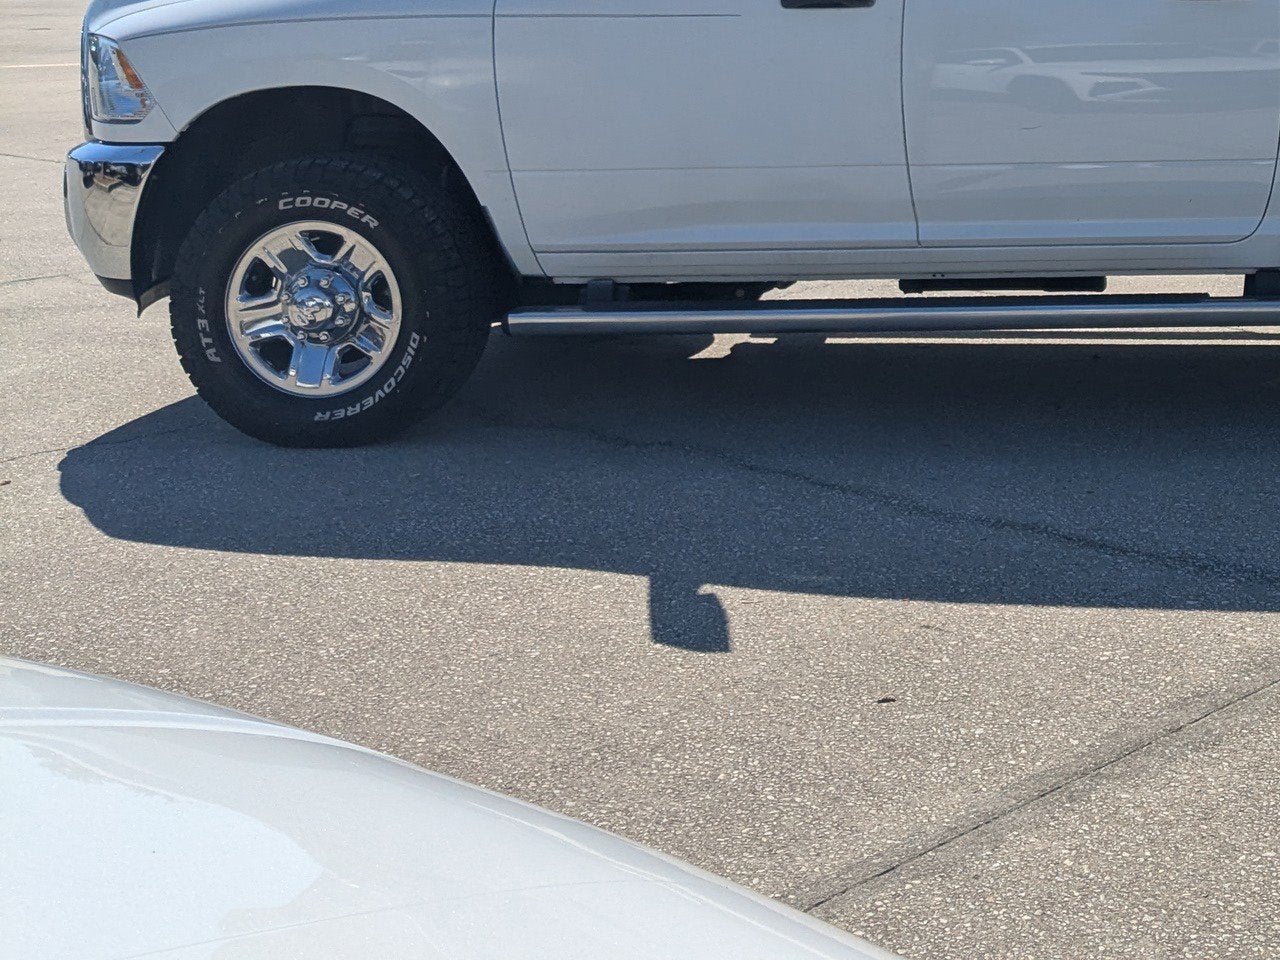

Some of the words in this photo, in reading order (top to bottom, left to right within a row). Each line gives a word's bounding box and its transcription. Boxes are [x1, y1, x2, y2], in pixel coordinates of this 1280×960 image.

[278, 195, 380, 229] COOPER
[197, 318, 222, 363] AT3
[314, 331, 421, 422] DISCOVERER
